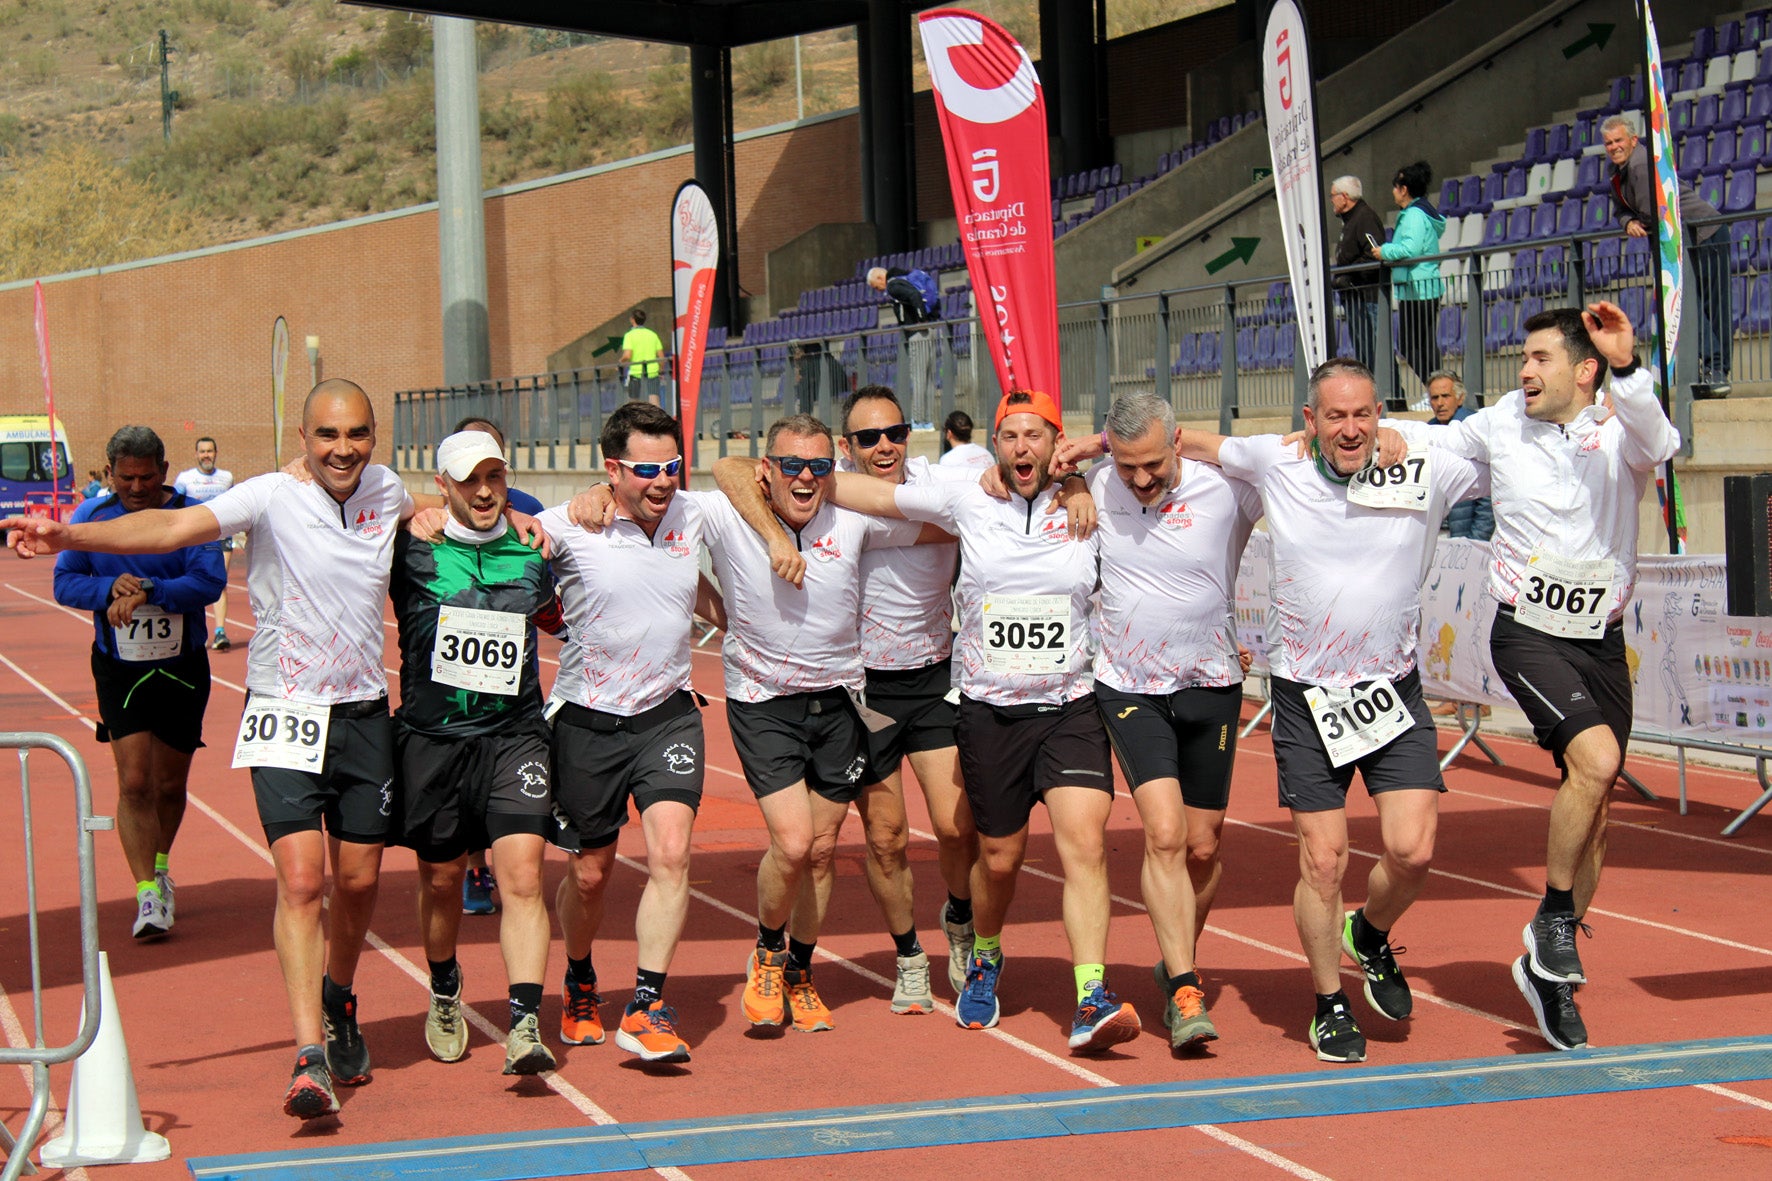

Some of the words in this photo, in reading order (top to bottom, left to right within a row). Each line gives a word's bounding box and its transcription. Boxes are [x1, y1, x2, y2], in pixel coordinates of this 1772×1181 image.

[1441, 543, 1472, 569] 2023
[1525, 575, 1607, 615] 3067
[128, 617, 172, 640] 713
[988, 620, 1065, 650] 3052
[440, 634, 519, 670] 3069
[1321, 687, 1395, 740] 3100
[1218, 724, 1228, 751] Joma
